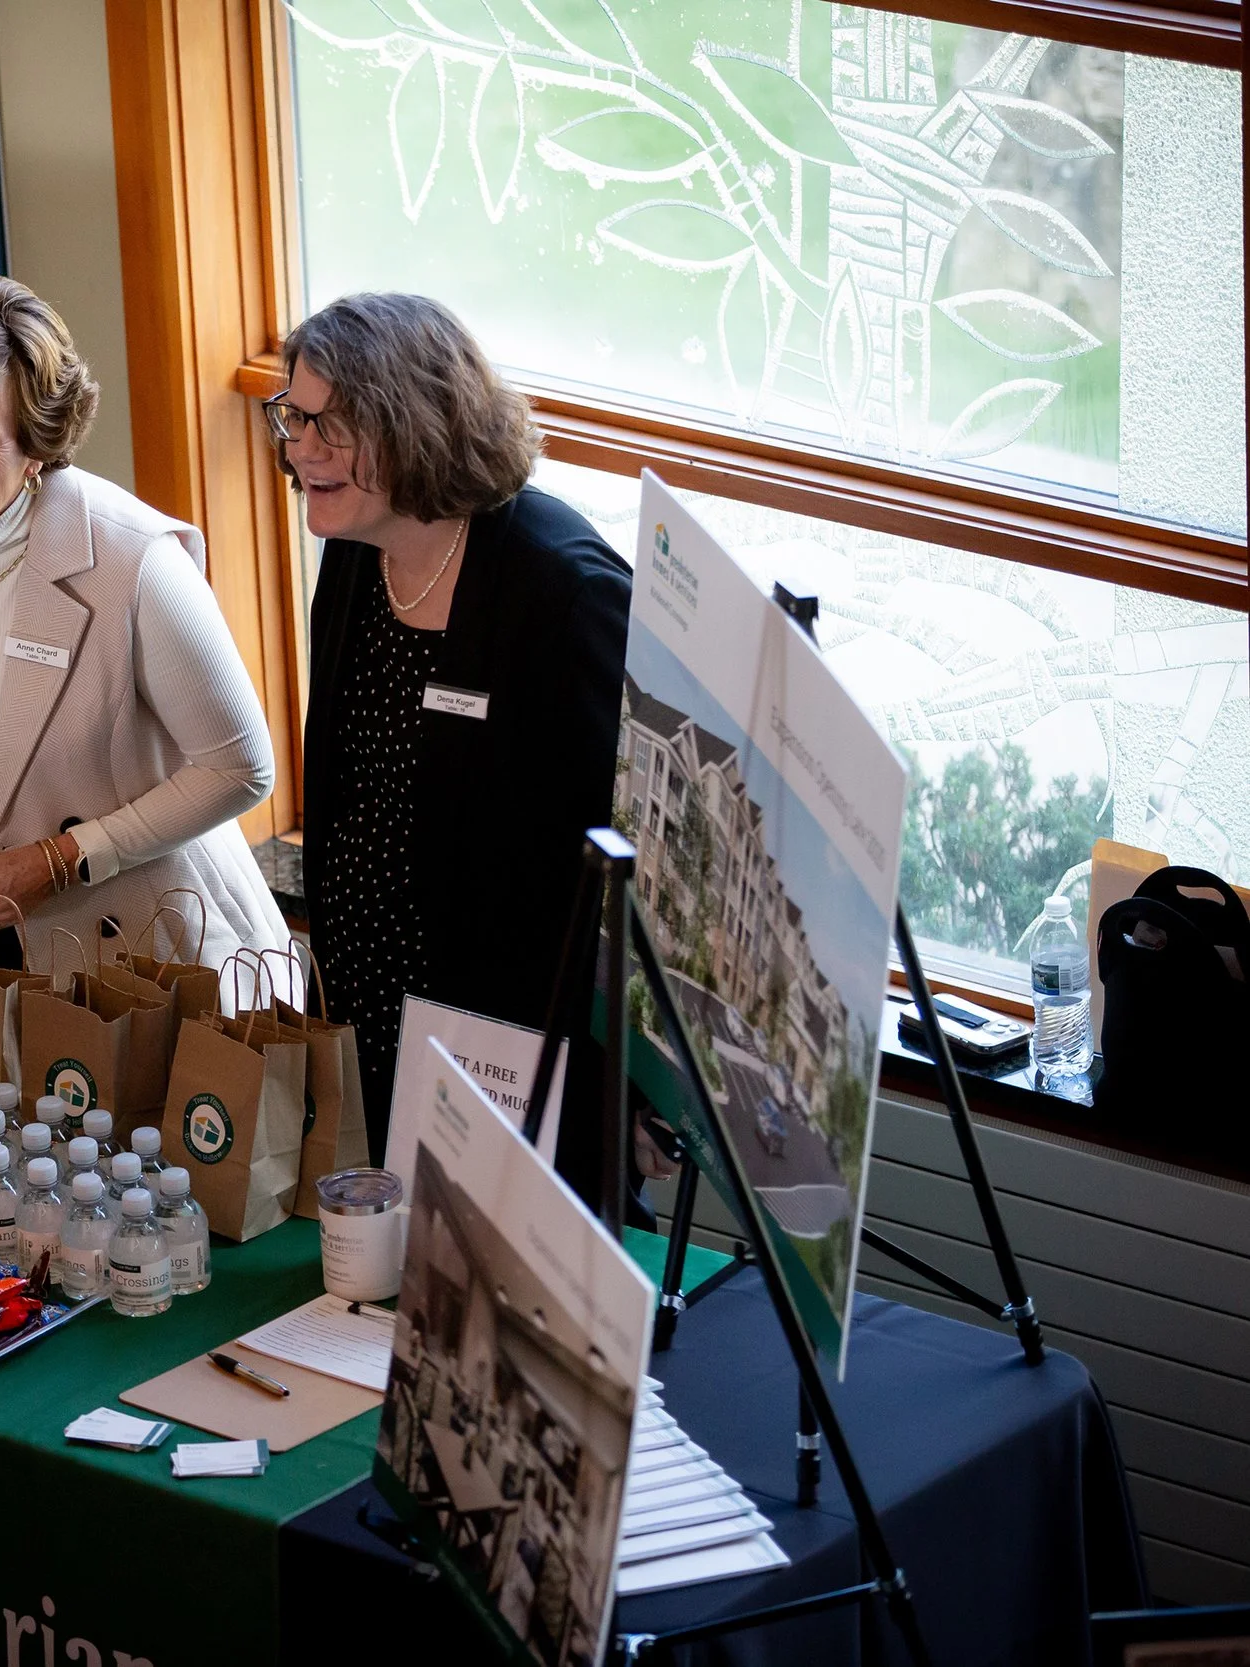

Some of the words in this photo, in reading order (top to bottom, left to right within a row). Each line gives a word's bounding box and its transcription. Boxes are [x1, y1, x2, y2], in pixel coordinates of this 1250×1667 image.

[16, 642, 35, 652] Anne
[36, 646, 58, 657] Chard
[437, 694, 454, 704] Dena
[54, 1060, 69, 1071] Treat
[69, 1060, 94, 1082] Yourself
[472, 1061, 480, 1074] A
[484, 1063, 518, 1084] FREE
[194, 1096, 210, 1105] Treat
[210, 1096, 230, 1122] Yourself
[202, 1150, 223, 1162] Hollow
[116, 1272, 169, 1288] Crossings
